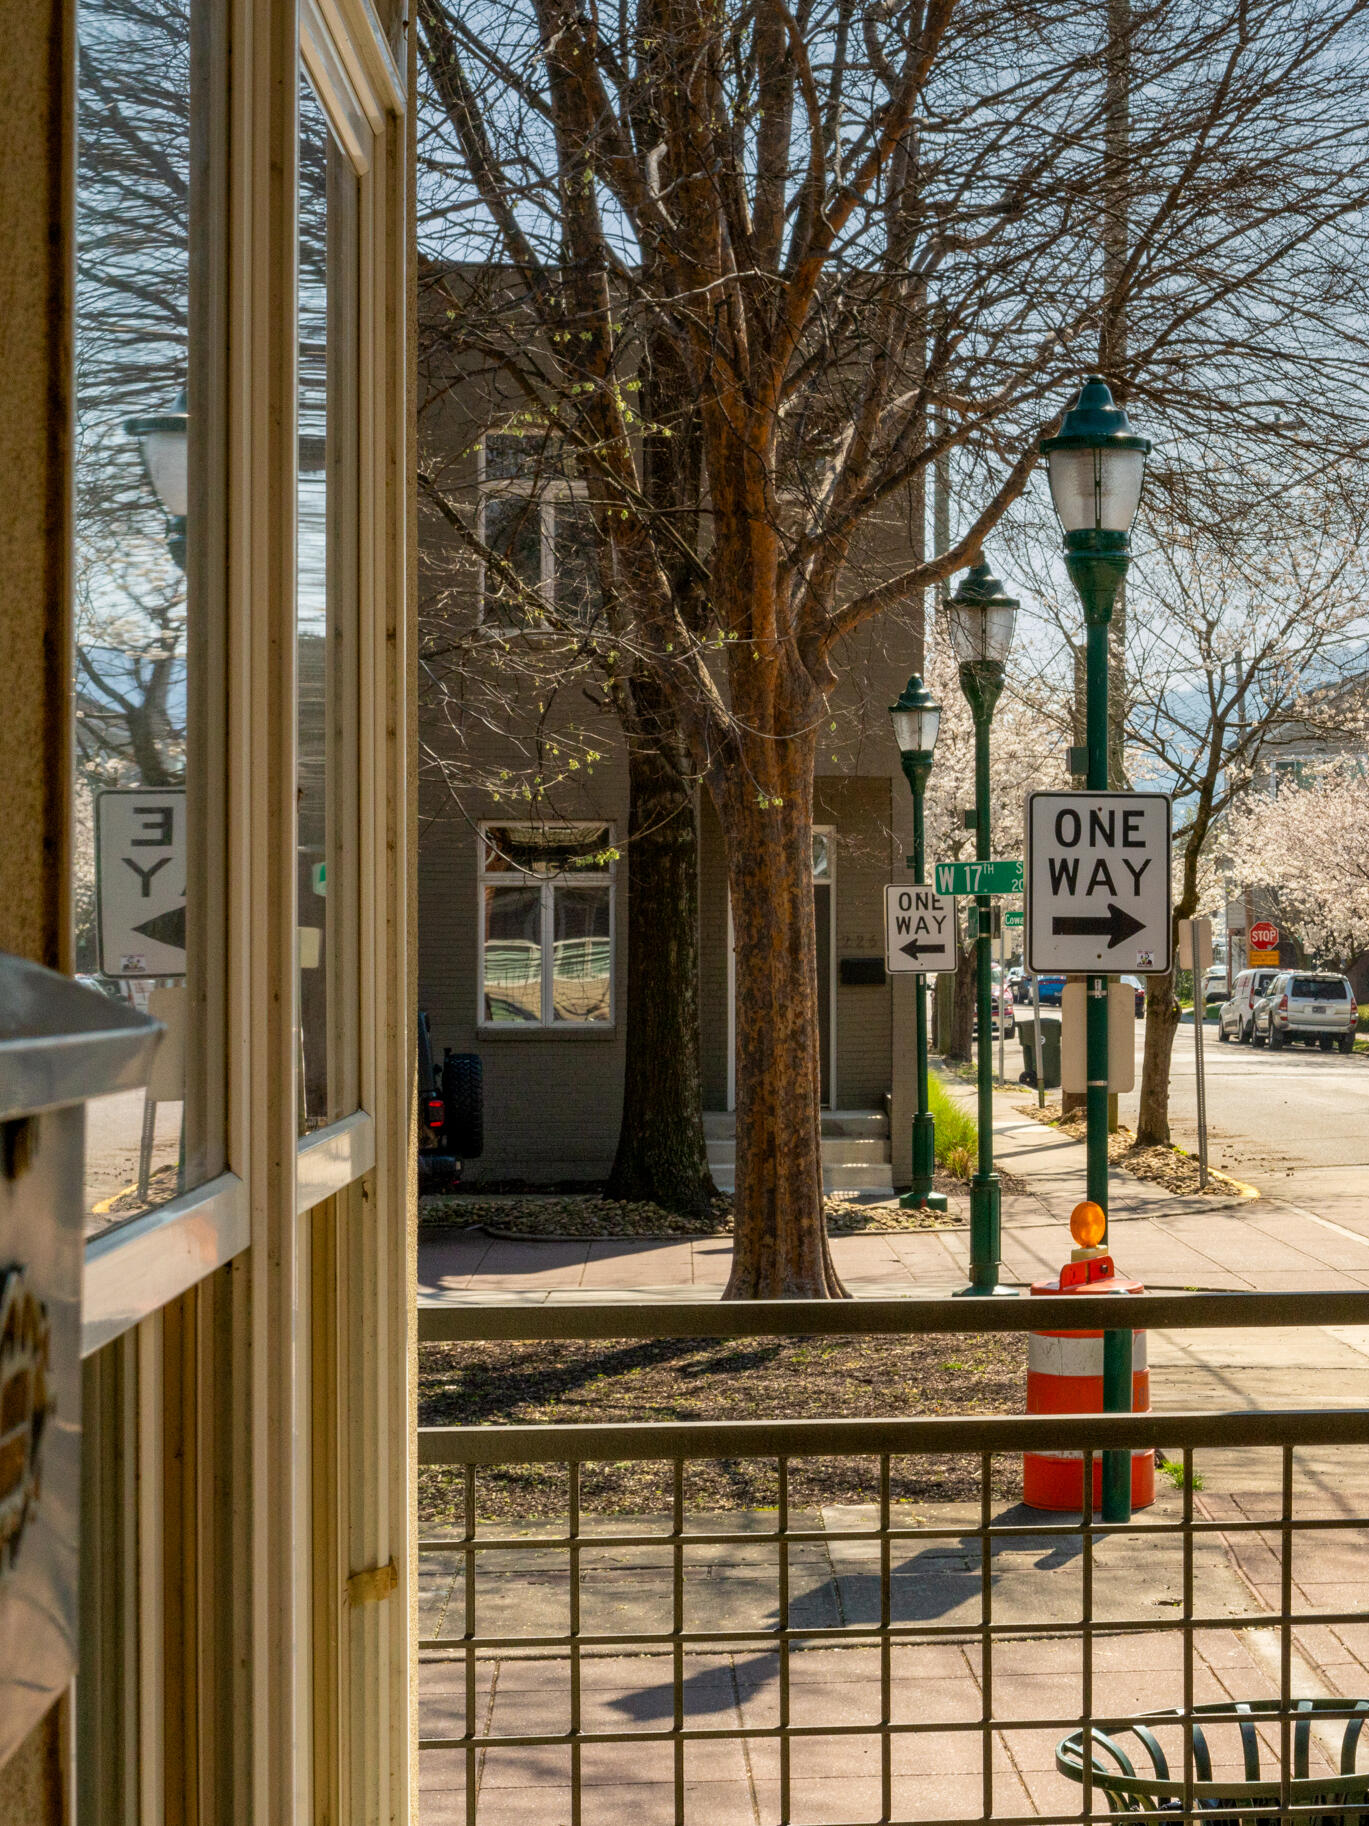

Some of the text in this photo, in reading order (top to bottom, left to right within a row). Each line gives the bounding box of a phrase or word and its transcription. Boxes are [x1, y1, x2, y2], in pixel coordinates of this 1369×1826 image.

[1054, 808, 1146, 848] ONE
[938, 866, 954, 893] W
[1048, 858, 1152, 897] WAY
[898, 891, 944, 911] ONE
[896, 915, 947, 935] WAY
[1251, 930, 1277, 942] STOP
